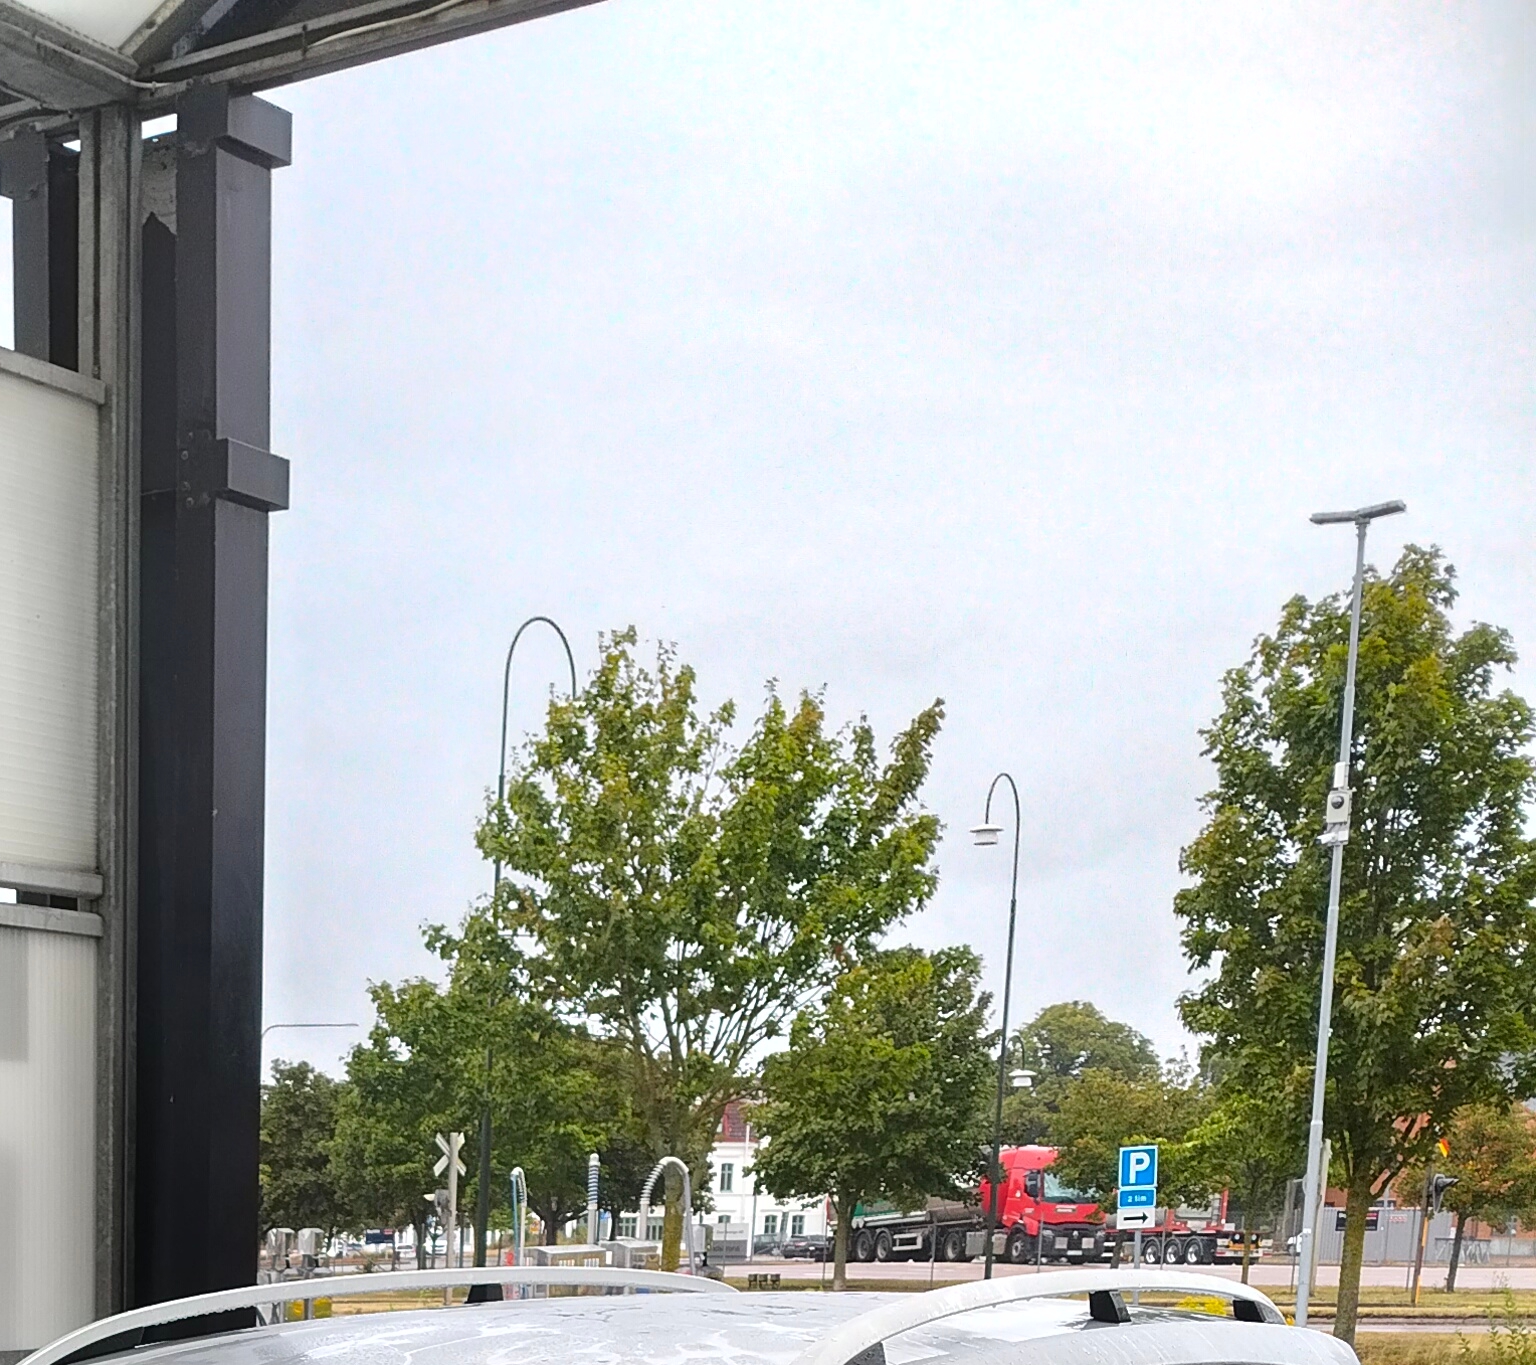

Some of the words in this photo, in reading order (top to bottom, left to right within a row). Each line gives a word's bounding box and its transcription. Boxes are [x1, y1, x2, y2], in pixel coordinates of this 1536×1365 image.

[1129, 1151, 1151, 1184] P
[1127, 1195, 1133, 1203] 2
[1134, 1194, 1147, 1203] tim
